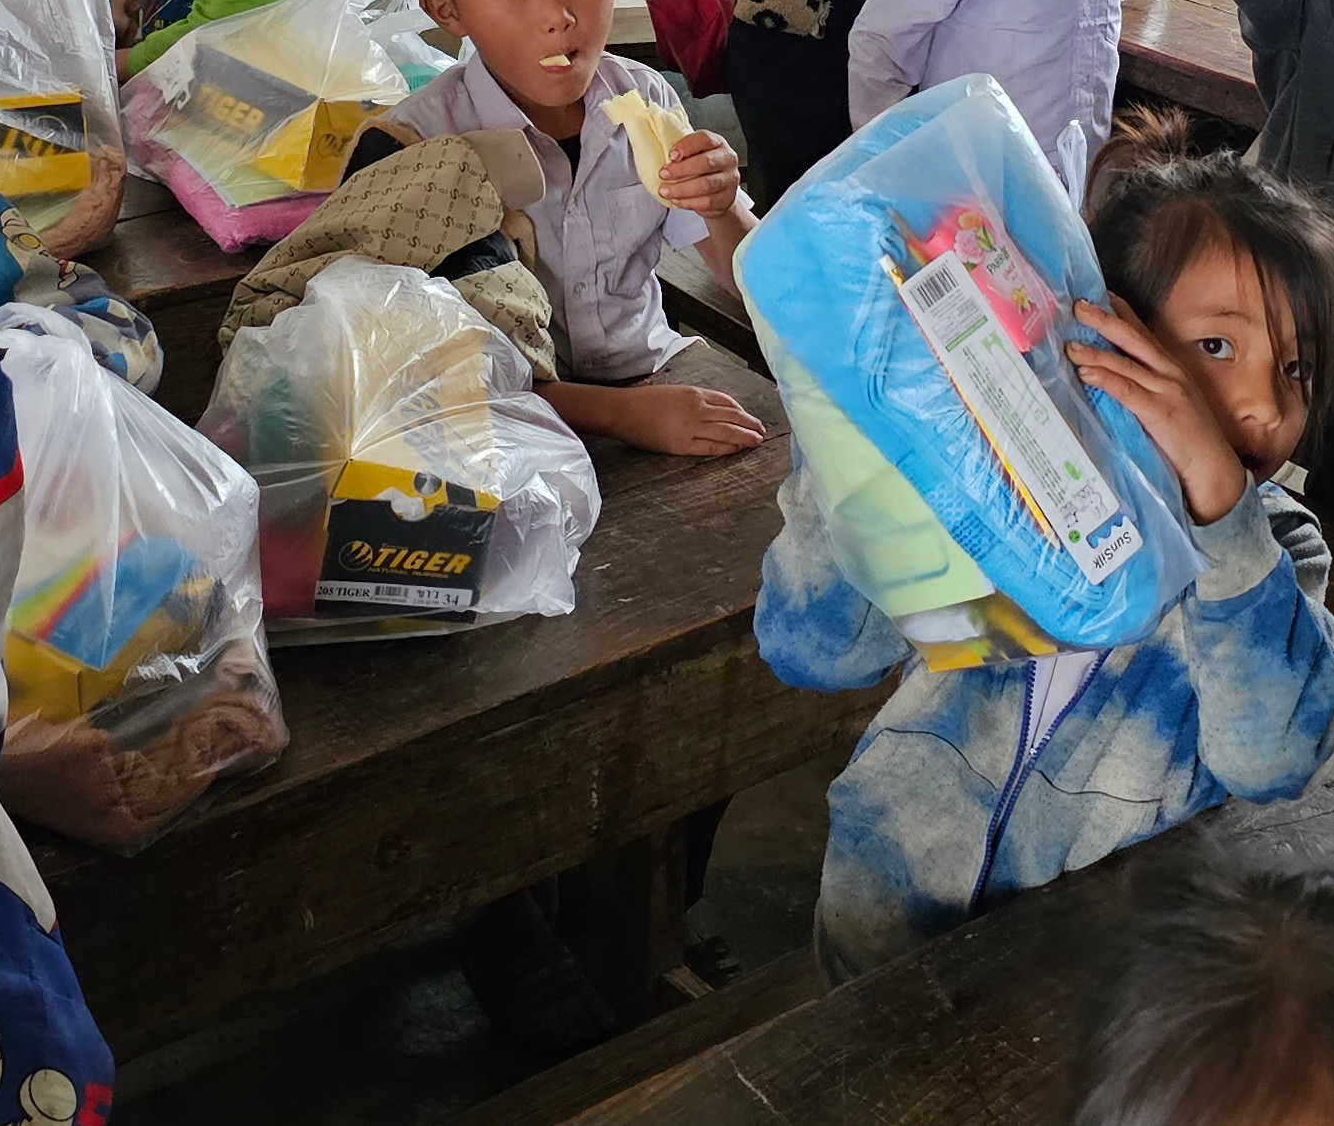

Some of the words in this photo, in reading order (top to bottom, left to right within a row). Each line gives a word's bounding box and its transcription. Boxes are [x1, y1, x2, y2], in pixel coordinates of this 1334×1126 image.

[373, 547, 472, 575] TIGER
[1091, 531, 1133, 571] SunSilk
[336, 586, 371, 598] TIGER
